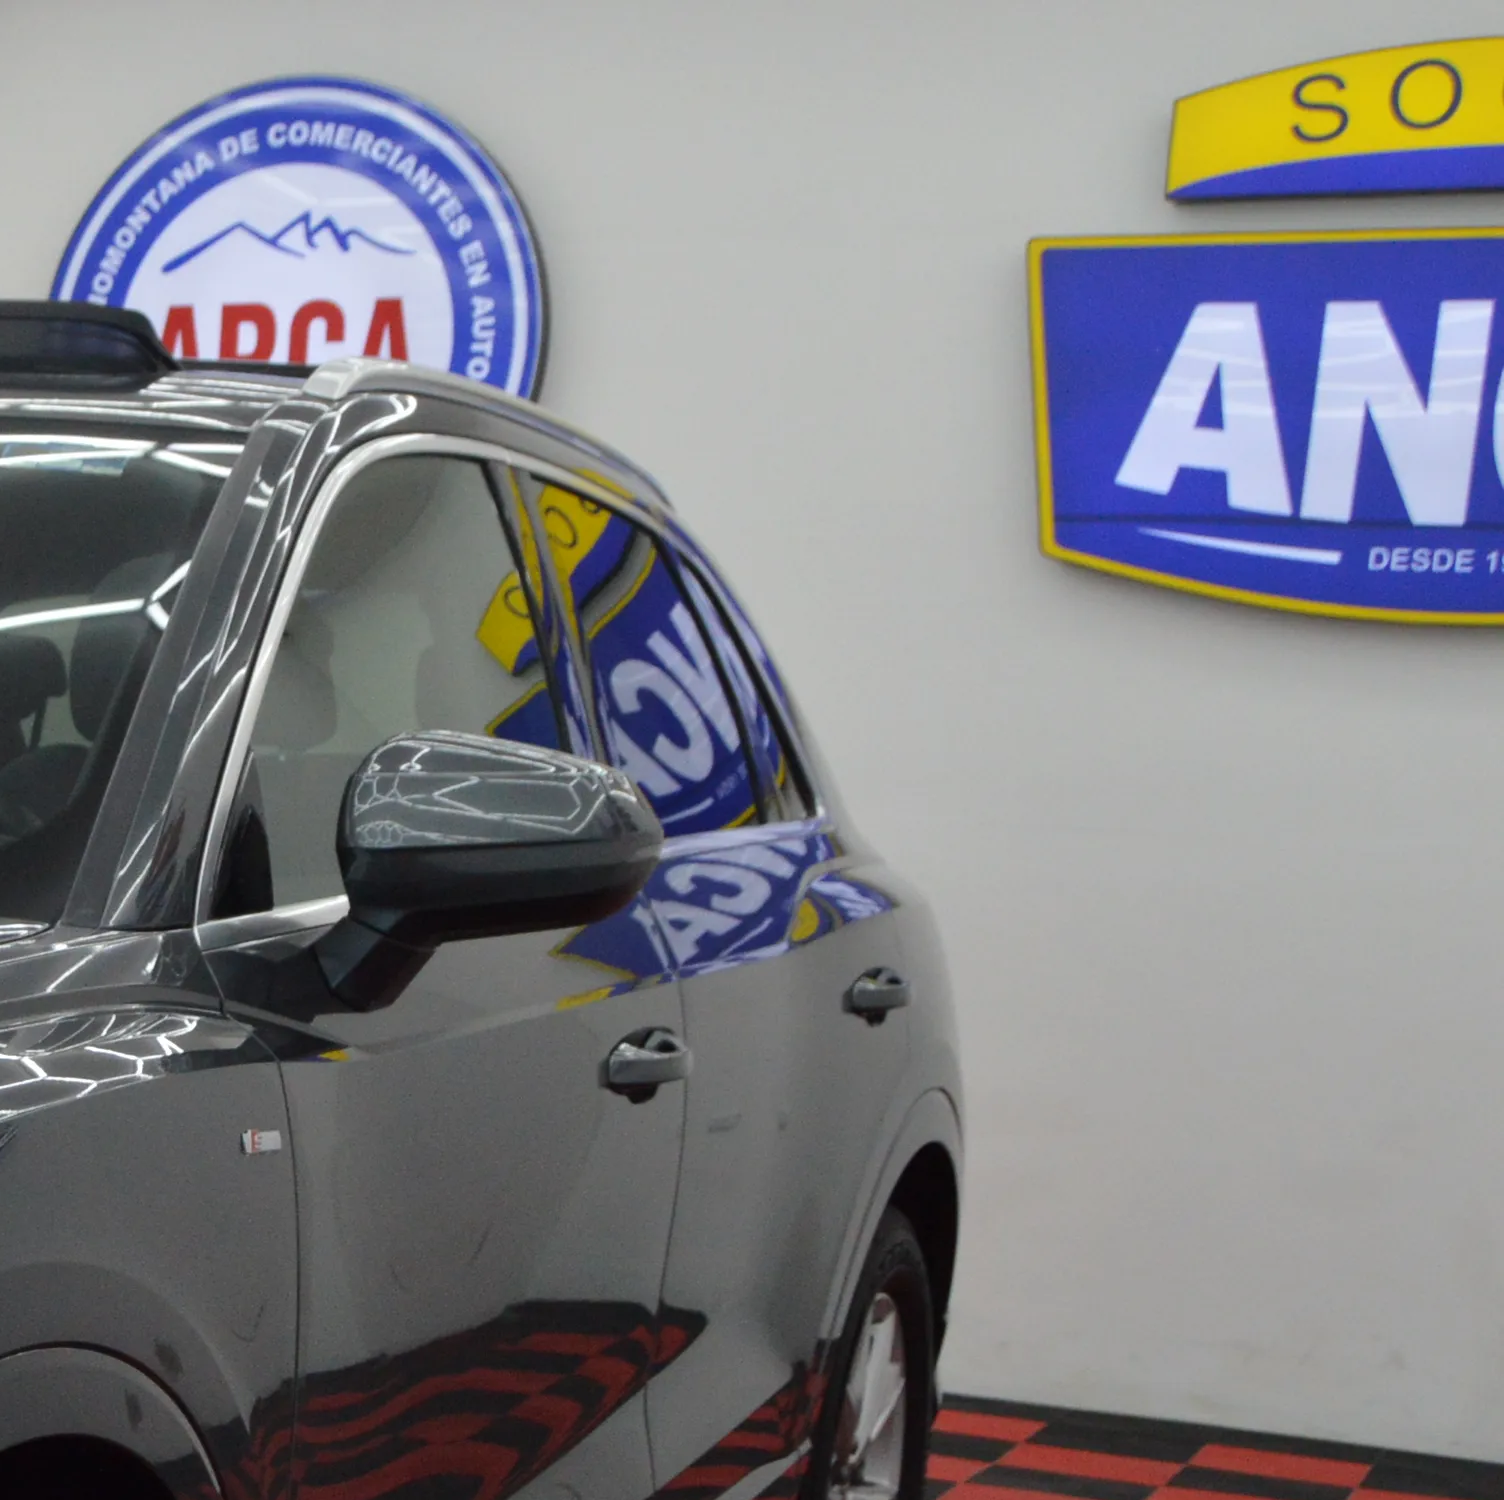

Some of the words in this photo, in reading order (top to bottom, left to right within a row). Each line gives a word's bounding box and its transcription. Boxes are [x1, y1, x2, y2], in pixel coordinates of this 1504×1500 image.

[1291, 57, 1504, 143] SO
[217, 128, 260, 161] DE
[266, 121, 473, 241] COMERCIANTES
[458, 239, 491, 288] EN
[1114, 299, 1504, 527] AN
[1367, 545, 1476, 573] DESDE
